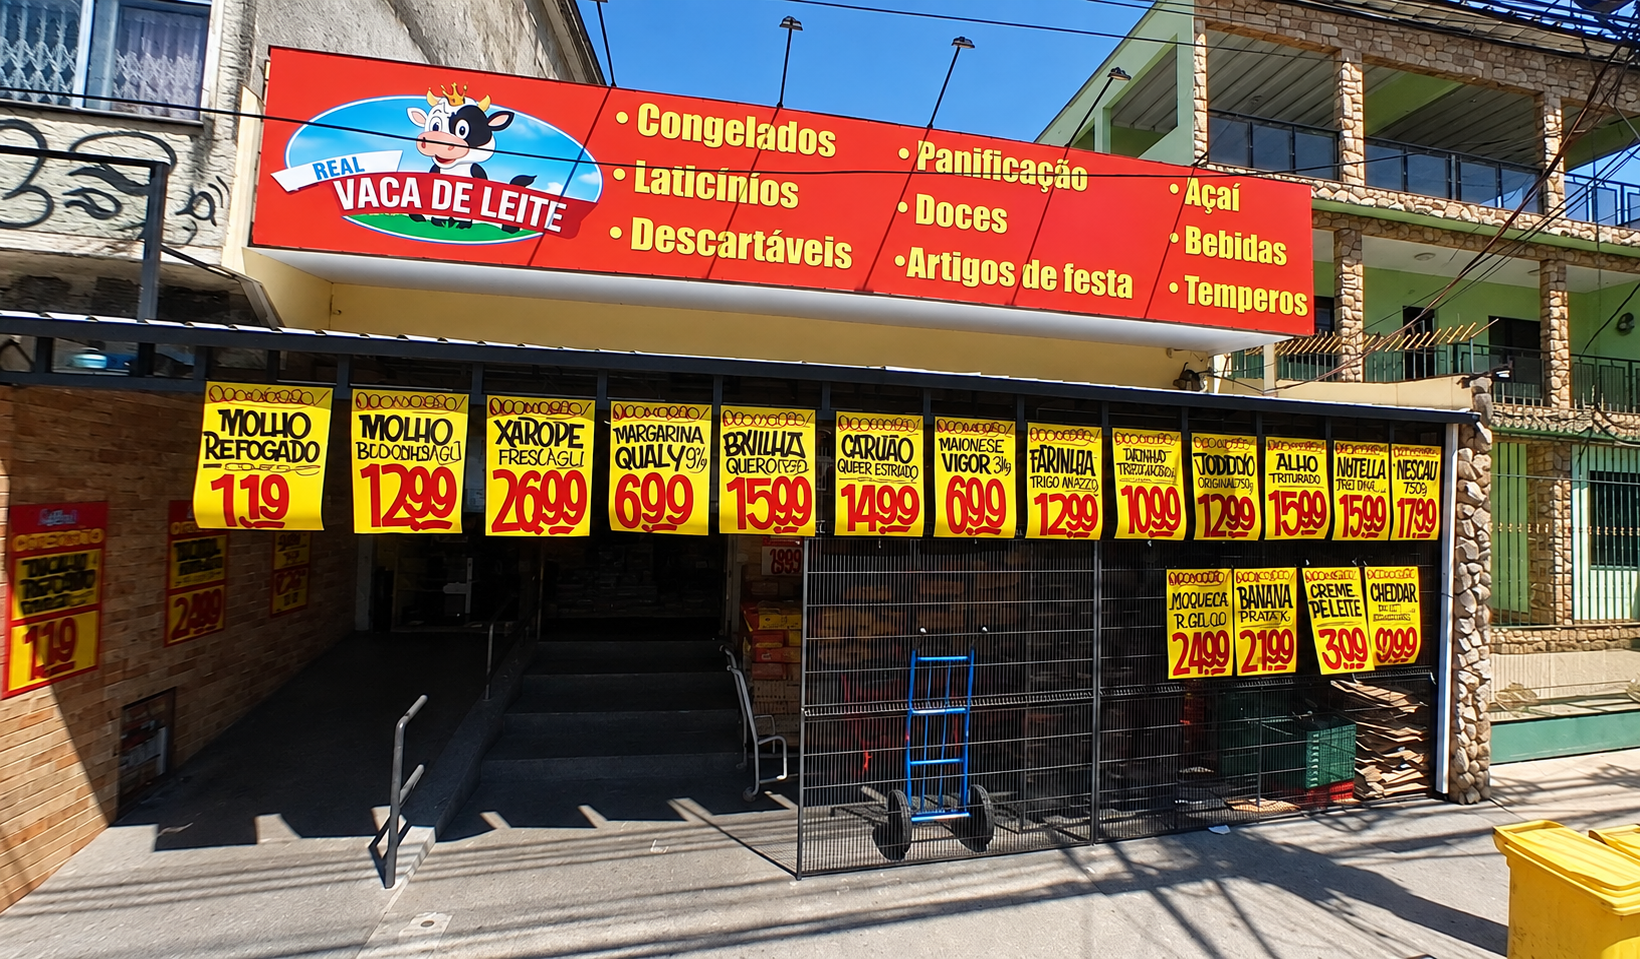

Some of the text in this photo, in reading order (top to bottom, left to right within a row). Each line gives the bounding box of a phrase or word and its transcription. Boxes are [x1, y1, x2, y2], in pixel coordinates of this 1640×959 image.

[637, 102, 838, 159] Congelados
[312, 156, 365, 180] REAL
[333, 177, 568, 233] VACA DE LEITE
[1184, 177, 1242, 214] Açaí
[915, 193, 1008, 234] Doces
[630, 216, 853, 270] Descartáveis
[1185, 225, 1287, 266] Bebidas
[906, 246, 1133, 300] Artigos de festa
[1184, 274, 1308, 317] Temperos
[217, 409, 312, 440] MOLHO
[358, 414, 454, 446] MOLHO
[493, 417, 585, 449] XAROPE
[613, 424, 704, 444] MARGARINA
[203, 431, 320, 463] REFOGADO
[615, 444, 686, 472] QUALY
[938, 437, 1005, 454] MAIONESE
[941, 453, 992, 475] VIGOR
[1276, 453, 1318, 473] ALHO
[1397, 459, 1438, 481] NESCAU
[1030, 476, 1060, 489] TRIGO
[1169, 592, 1229, 610] MOQUECA
[1236, 584, 1293, 610] BANANA
[1310, 583, 1356, 599] CREME
[1370, 583, 1418, 603] CHEDDAR
